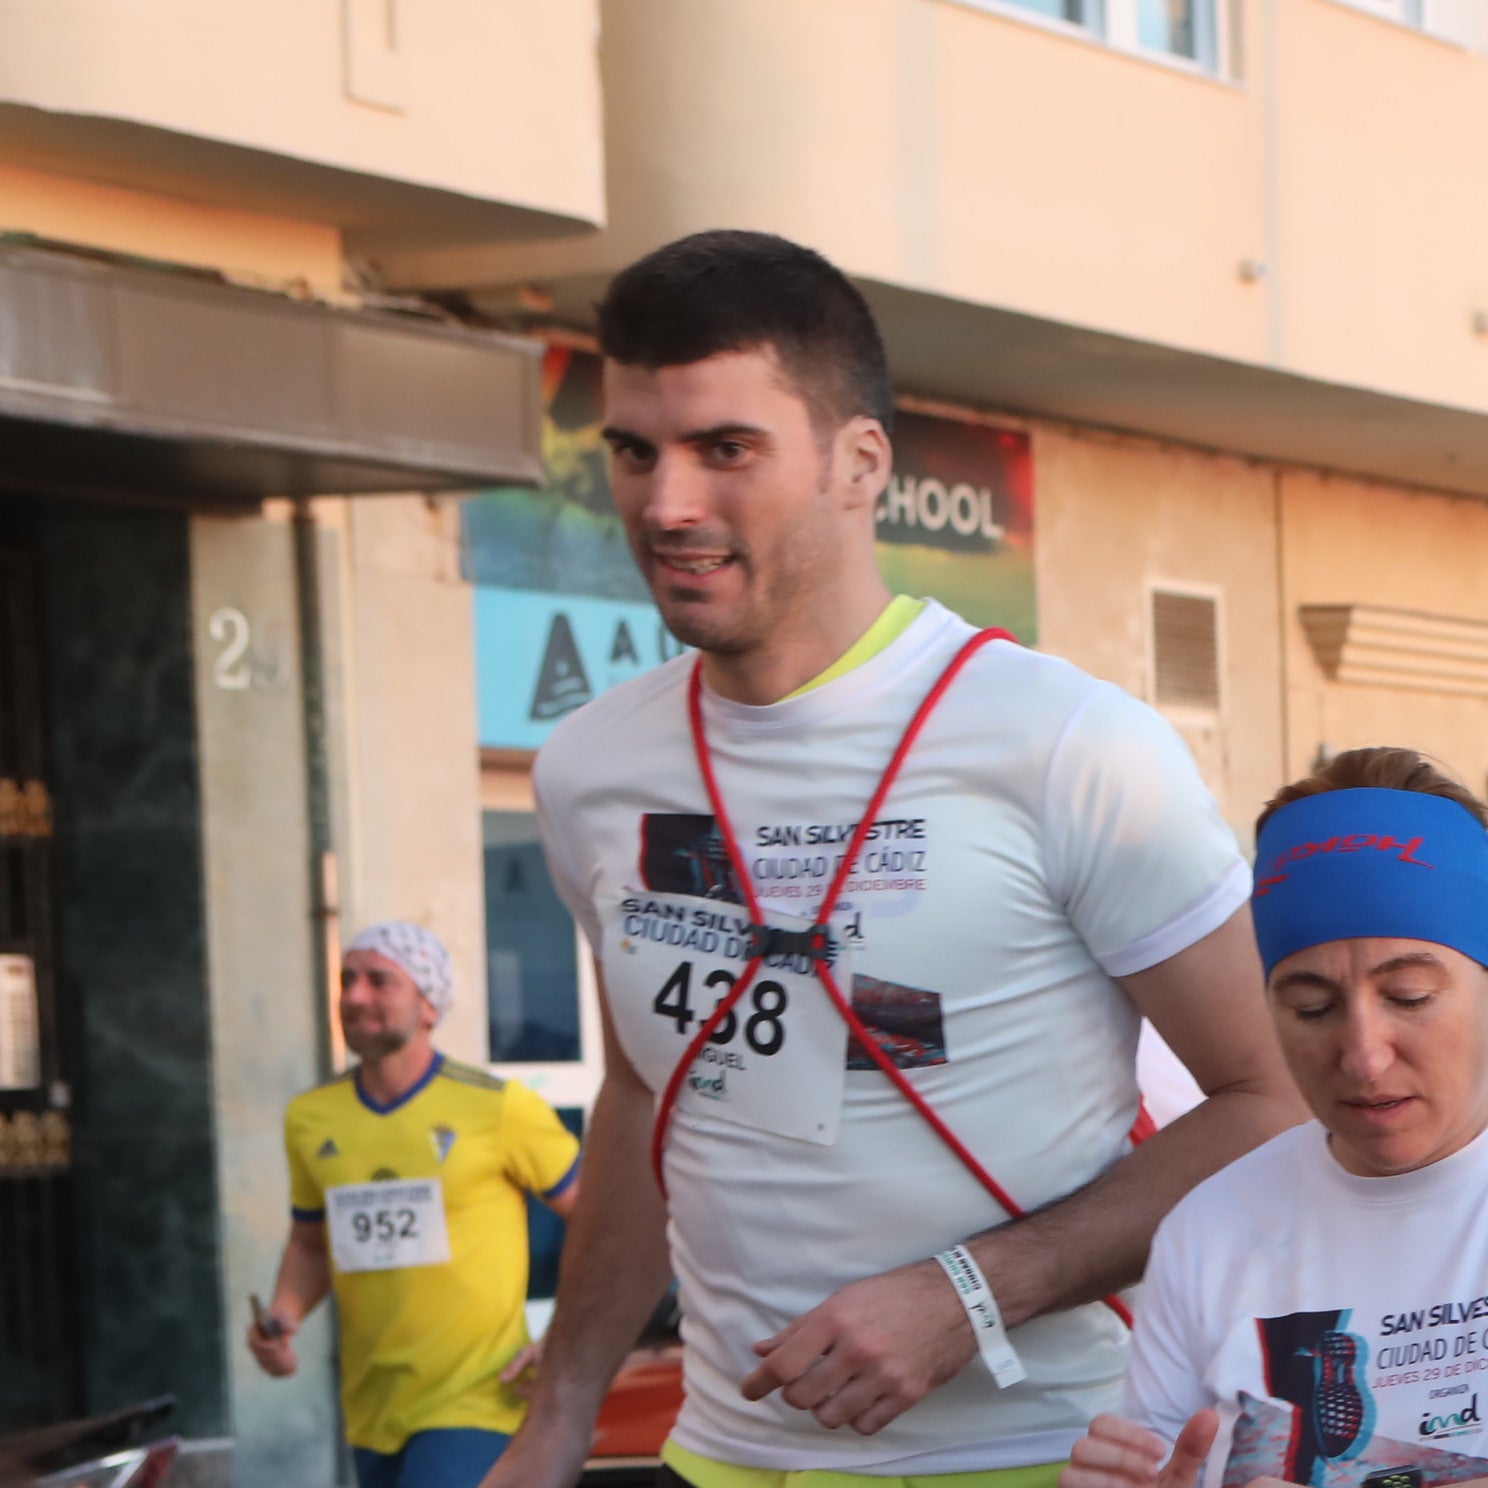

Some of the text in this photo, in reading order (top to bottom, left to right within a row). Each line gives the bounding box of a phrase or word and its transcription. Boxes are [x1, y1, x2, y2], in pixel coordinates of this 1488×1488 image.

[875, 474, 1004, 540] HOOL
[755, 819, 927, 847] SAN SILVSTRE
[752, 856, 828, 881] CIUDAD
[864, 846, 927, 874] CÁDIZ
[621, 898, 684, 922] SAN
[623, 915, 716, 954] CIUDAD
[653, 960, 789, 1057] 438
[351, 1208, 418, 1243] 952
[1380, 1309, 1426, 1336] SAN
[1376, 1338, 1448, 1370] CIUDAD
[1454, 1331, 1477, 1357] DE
[1371, 1370, 1420, 1389] JUEVES
[1423, 1367, 1441, 1382] 29
[1444, 1363, 1461, 1378] DE
[1419, 1393, 1482, 1436] imd
